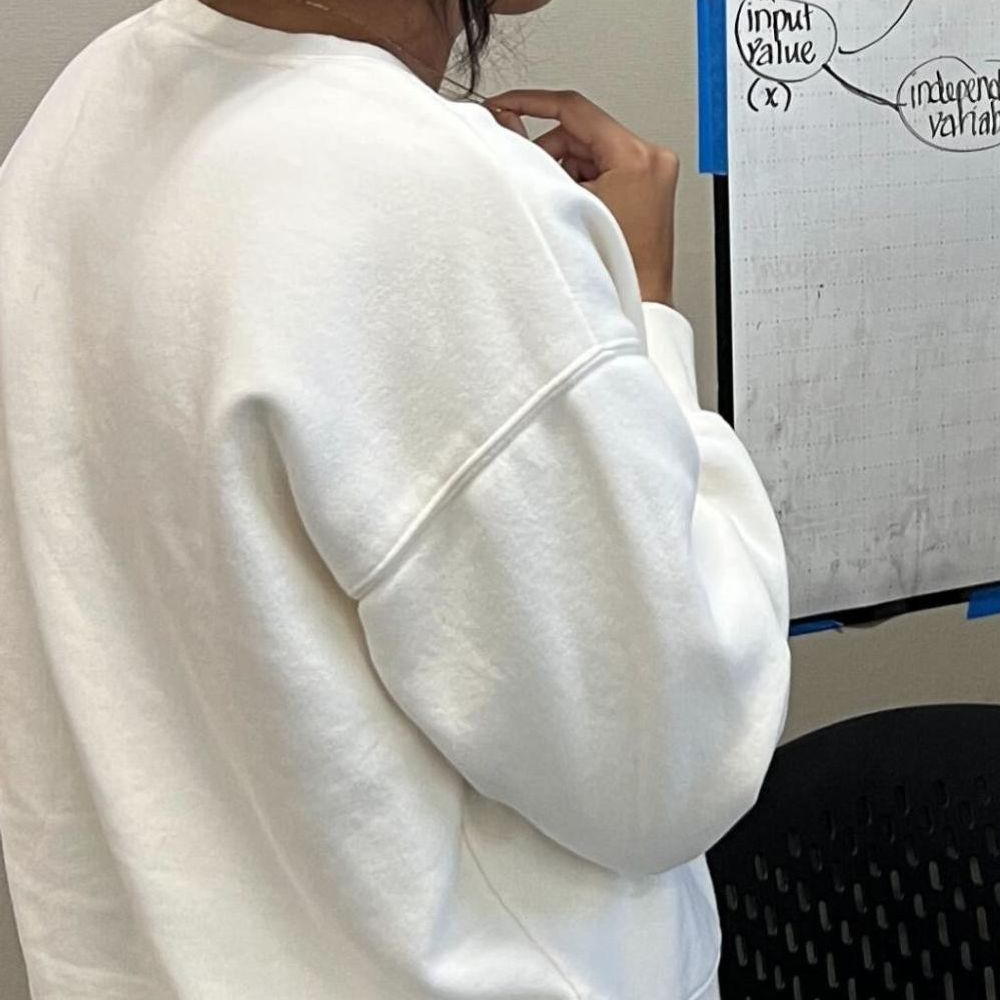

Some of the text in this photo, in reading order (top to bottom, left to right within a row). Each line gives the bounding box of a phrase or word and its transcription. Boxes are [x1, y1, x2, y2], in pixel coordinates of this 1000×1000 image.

[747, 2, 814, 41] input
[747, 37, 816, 66] value
[748, 78, 791, 112] (x)
